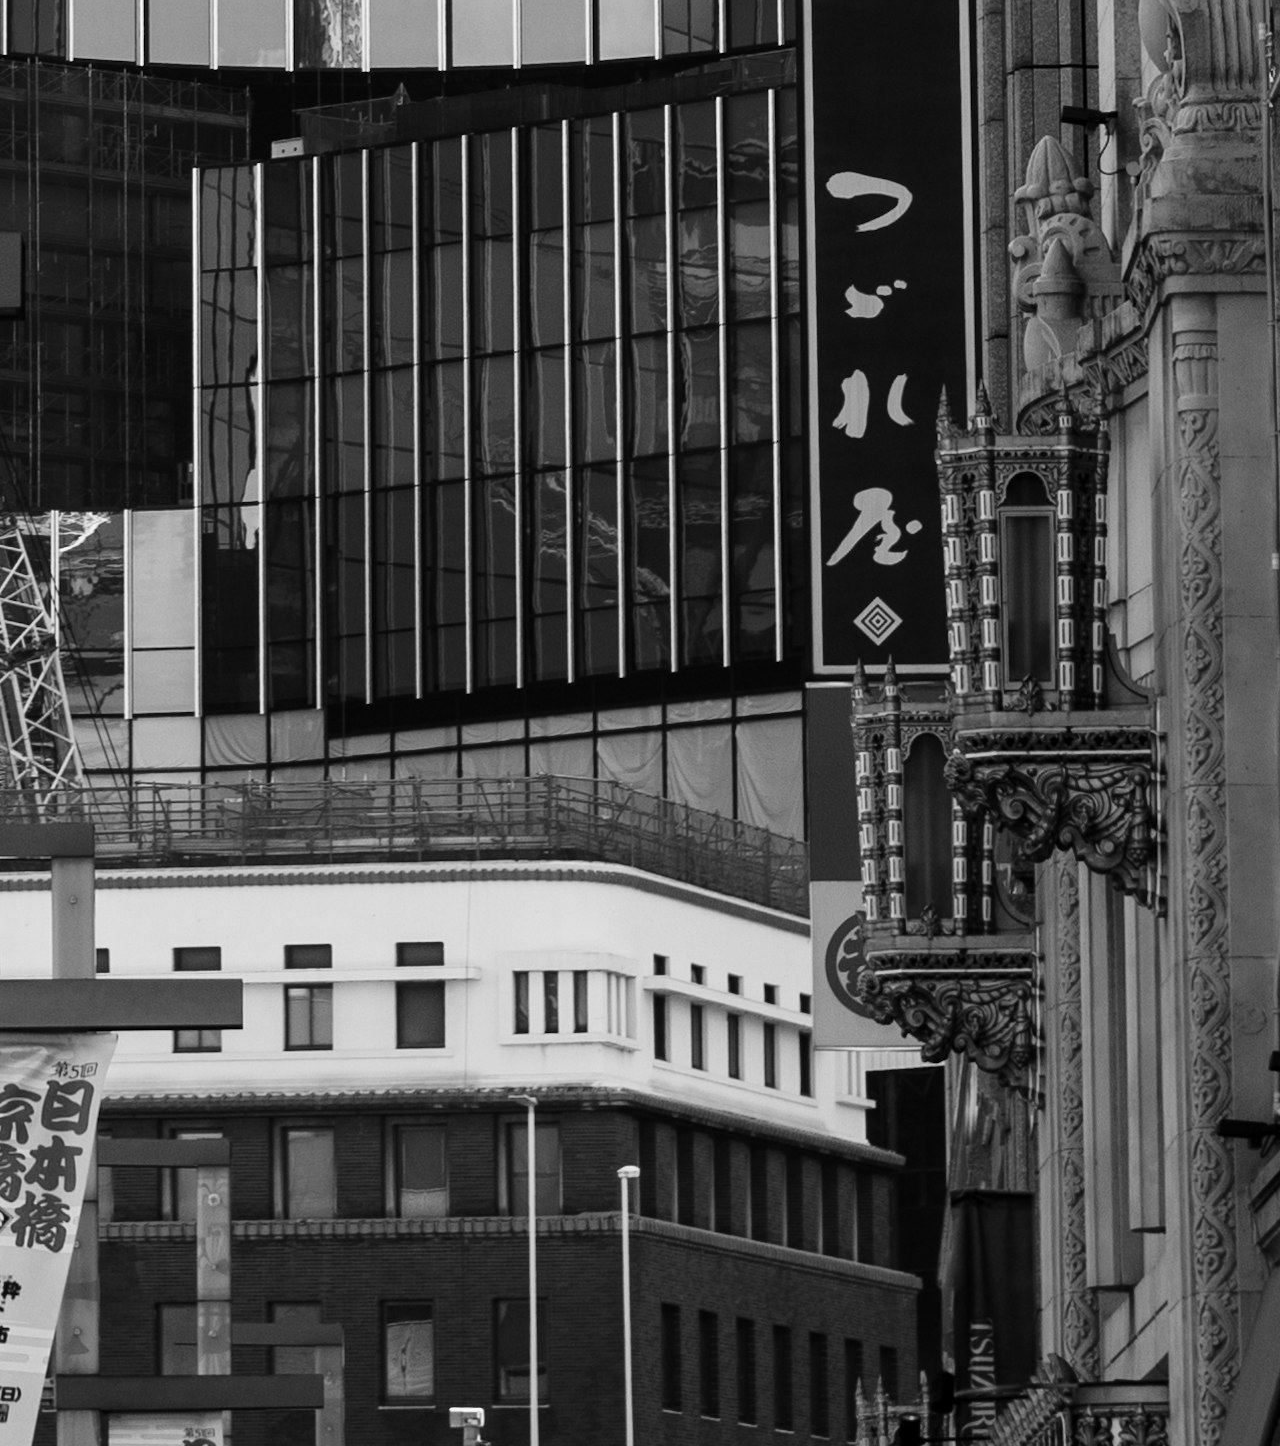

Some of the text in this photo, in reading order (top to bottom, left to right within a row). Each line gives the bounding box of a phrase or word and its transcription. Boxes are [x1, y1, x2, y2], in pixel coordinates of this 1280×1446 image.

[51, 1061, 99, 1079] 第51回
[10, 1079, 95, 1253] 日本橋
